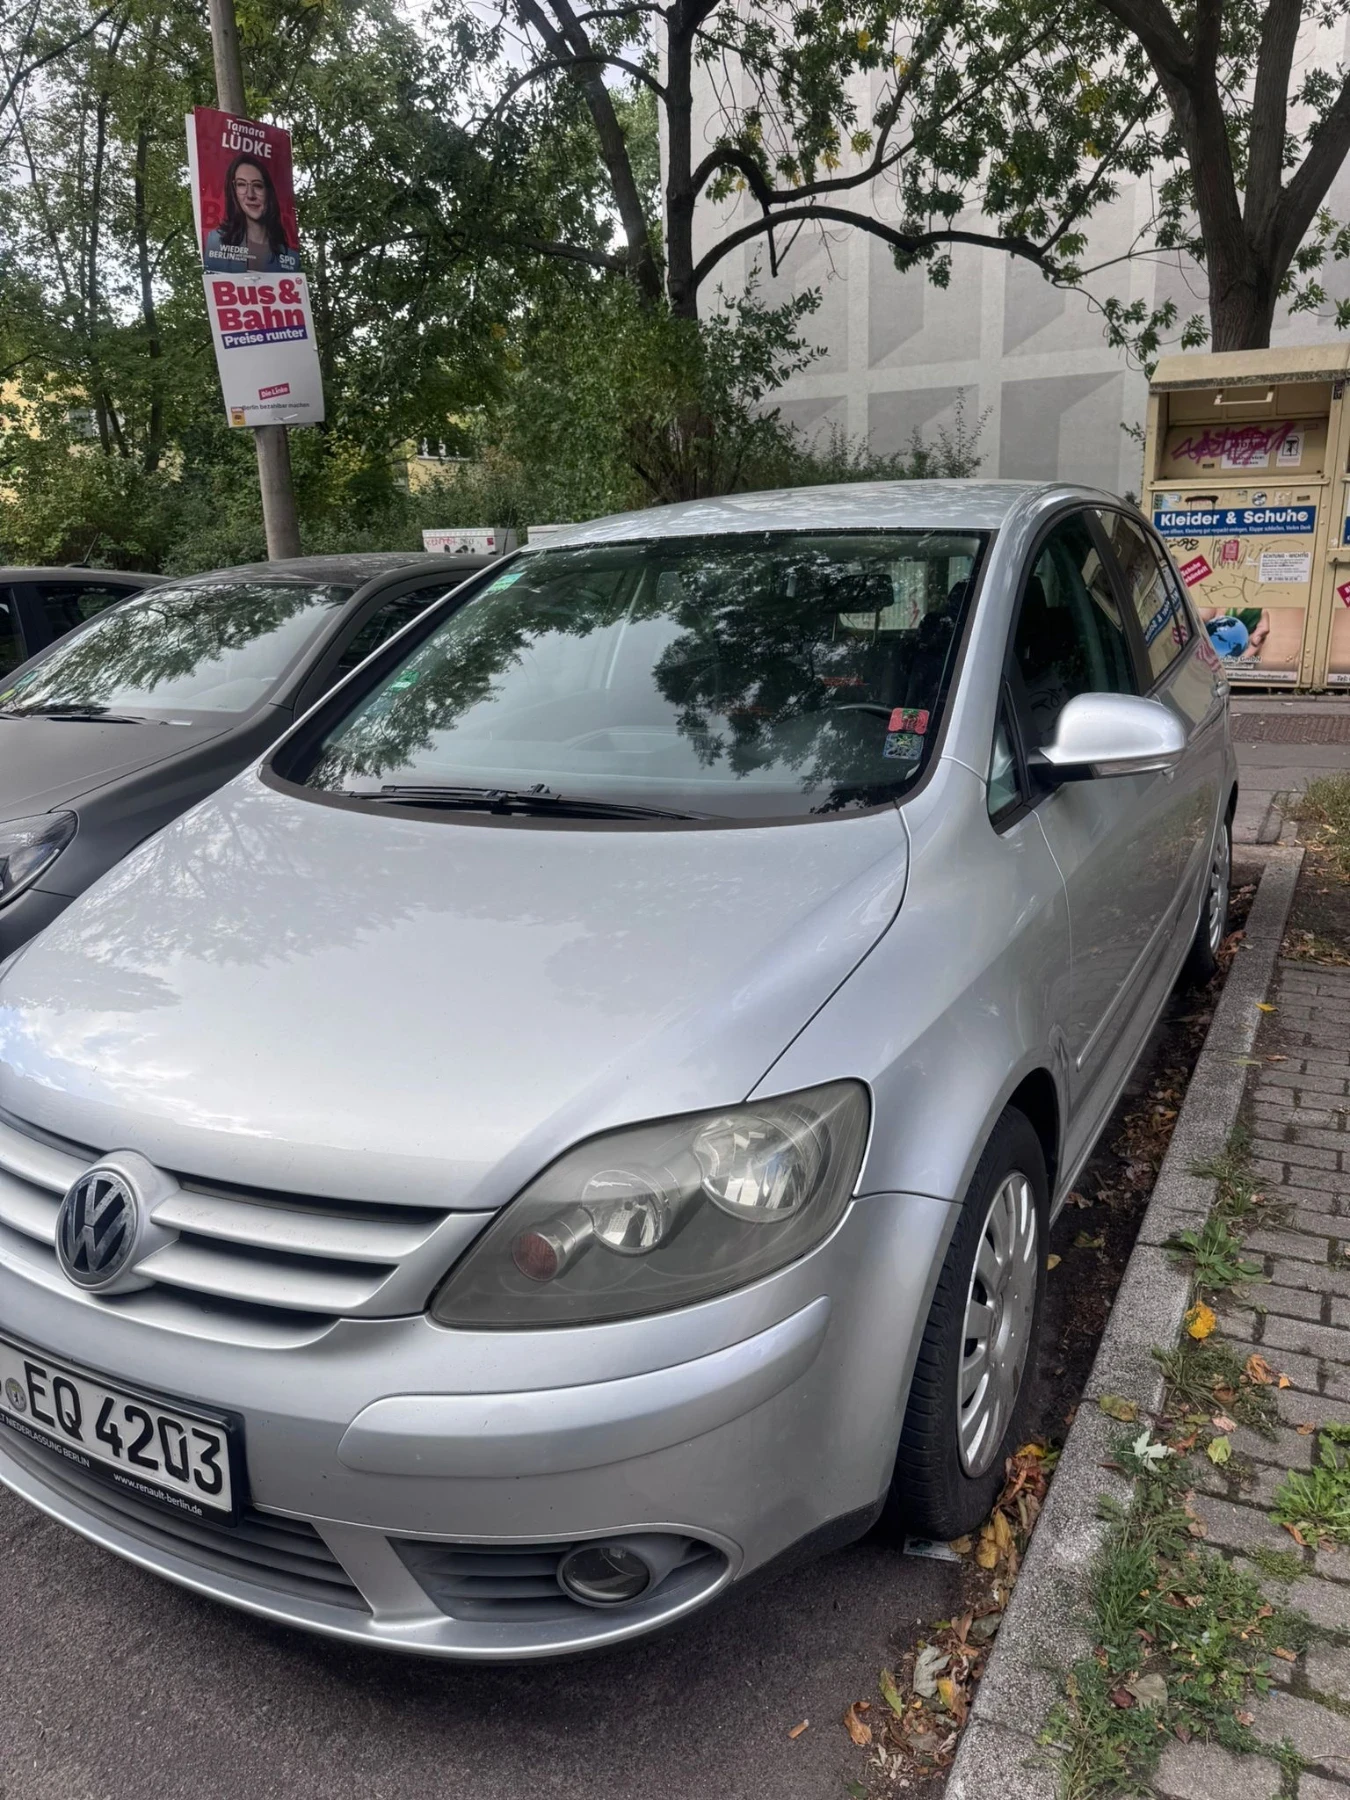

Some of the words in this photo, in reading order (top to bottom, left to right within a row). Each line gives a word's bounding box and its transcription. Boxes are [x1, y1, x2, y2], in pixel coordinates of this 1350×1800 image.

[226, 119, 265, 138] Tamara
[221, 131, 272, 159] LÜDKE
[208, 250, 235, 260] BERLIN
[220, 244, 249, 254] WIEDER
[279, 254, 296, 265] SPD
[217, 306, 305, 331] Bahn
[224, 332, 264, 347] Preise
[266, 328, 304, 342] runter
[260, 390, 271, 398] Die
[271, 386, 288, 395] Linke
[1160, 512, 1220, 526] Kleider
[1225, 511, 1237, 524] &
[1243, 509, 1308, 524] Schuhe
[23, 1360, 84, 1442] EQ
[95, 1395, 223, 1495] 4203
[6, 1417, 62, 1454] NIEDERLASSUNG
[62, 1447, 90, 1468] BERLIN
[113, 1472, 203, 1516] www.renault-berlin.de
